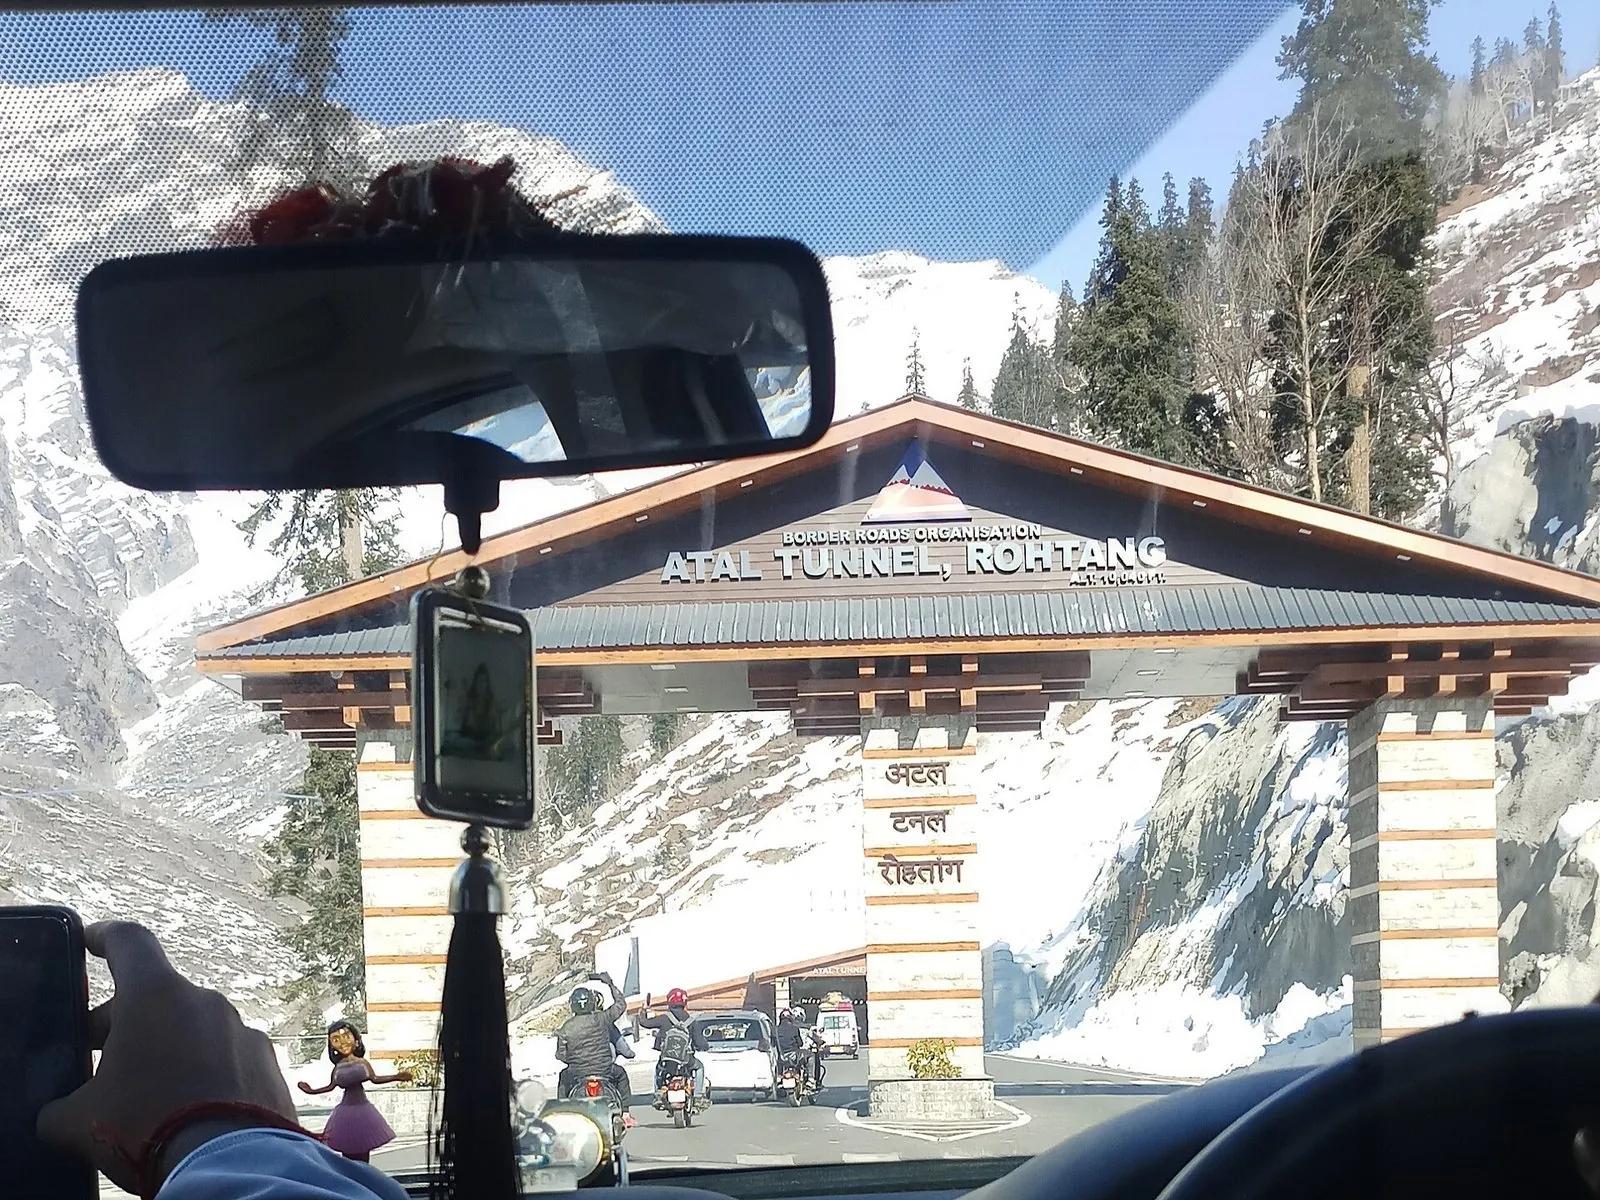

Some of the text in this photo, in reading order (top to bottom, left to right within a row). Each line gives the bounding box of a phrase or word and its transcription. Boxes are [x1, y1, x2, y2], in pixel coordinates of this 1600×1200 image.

[783, 524, 1041, 546] BORDER ROADS ORGANISATION
[661, 536, 1166, 584] ATAL TUNNEL, ROHTANG
[885, 762, 950, 787] अटल
[890, 810, 950, 834] टनल
[877, 854, 964, 885] रोहतांग
[813, 966, 866, 975] ATAL TUNNE
